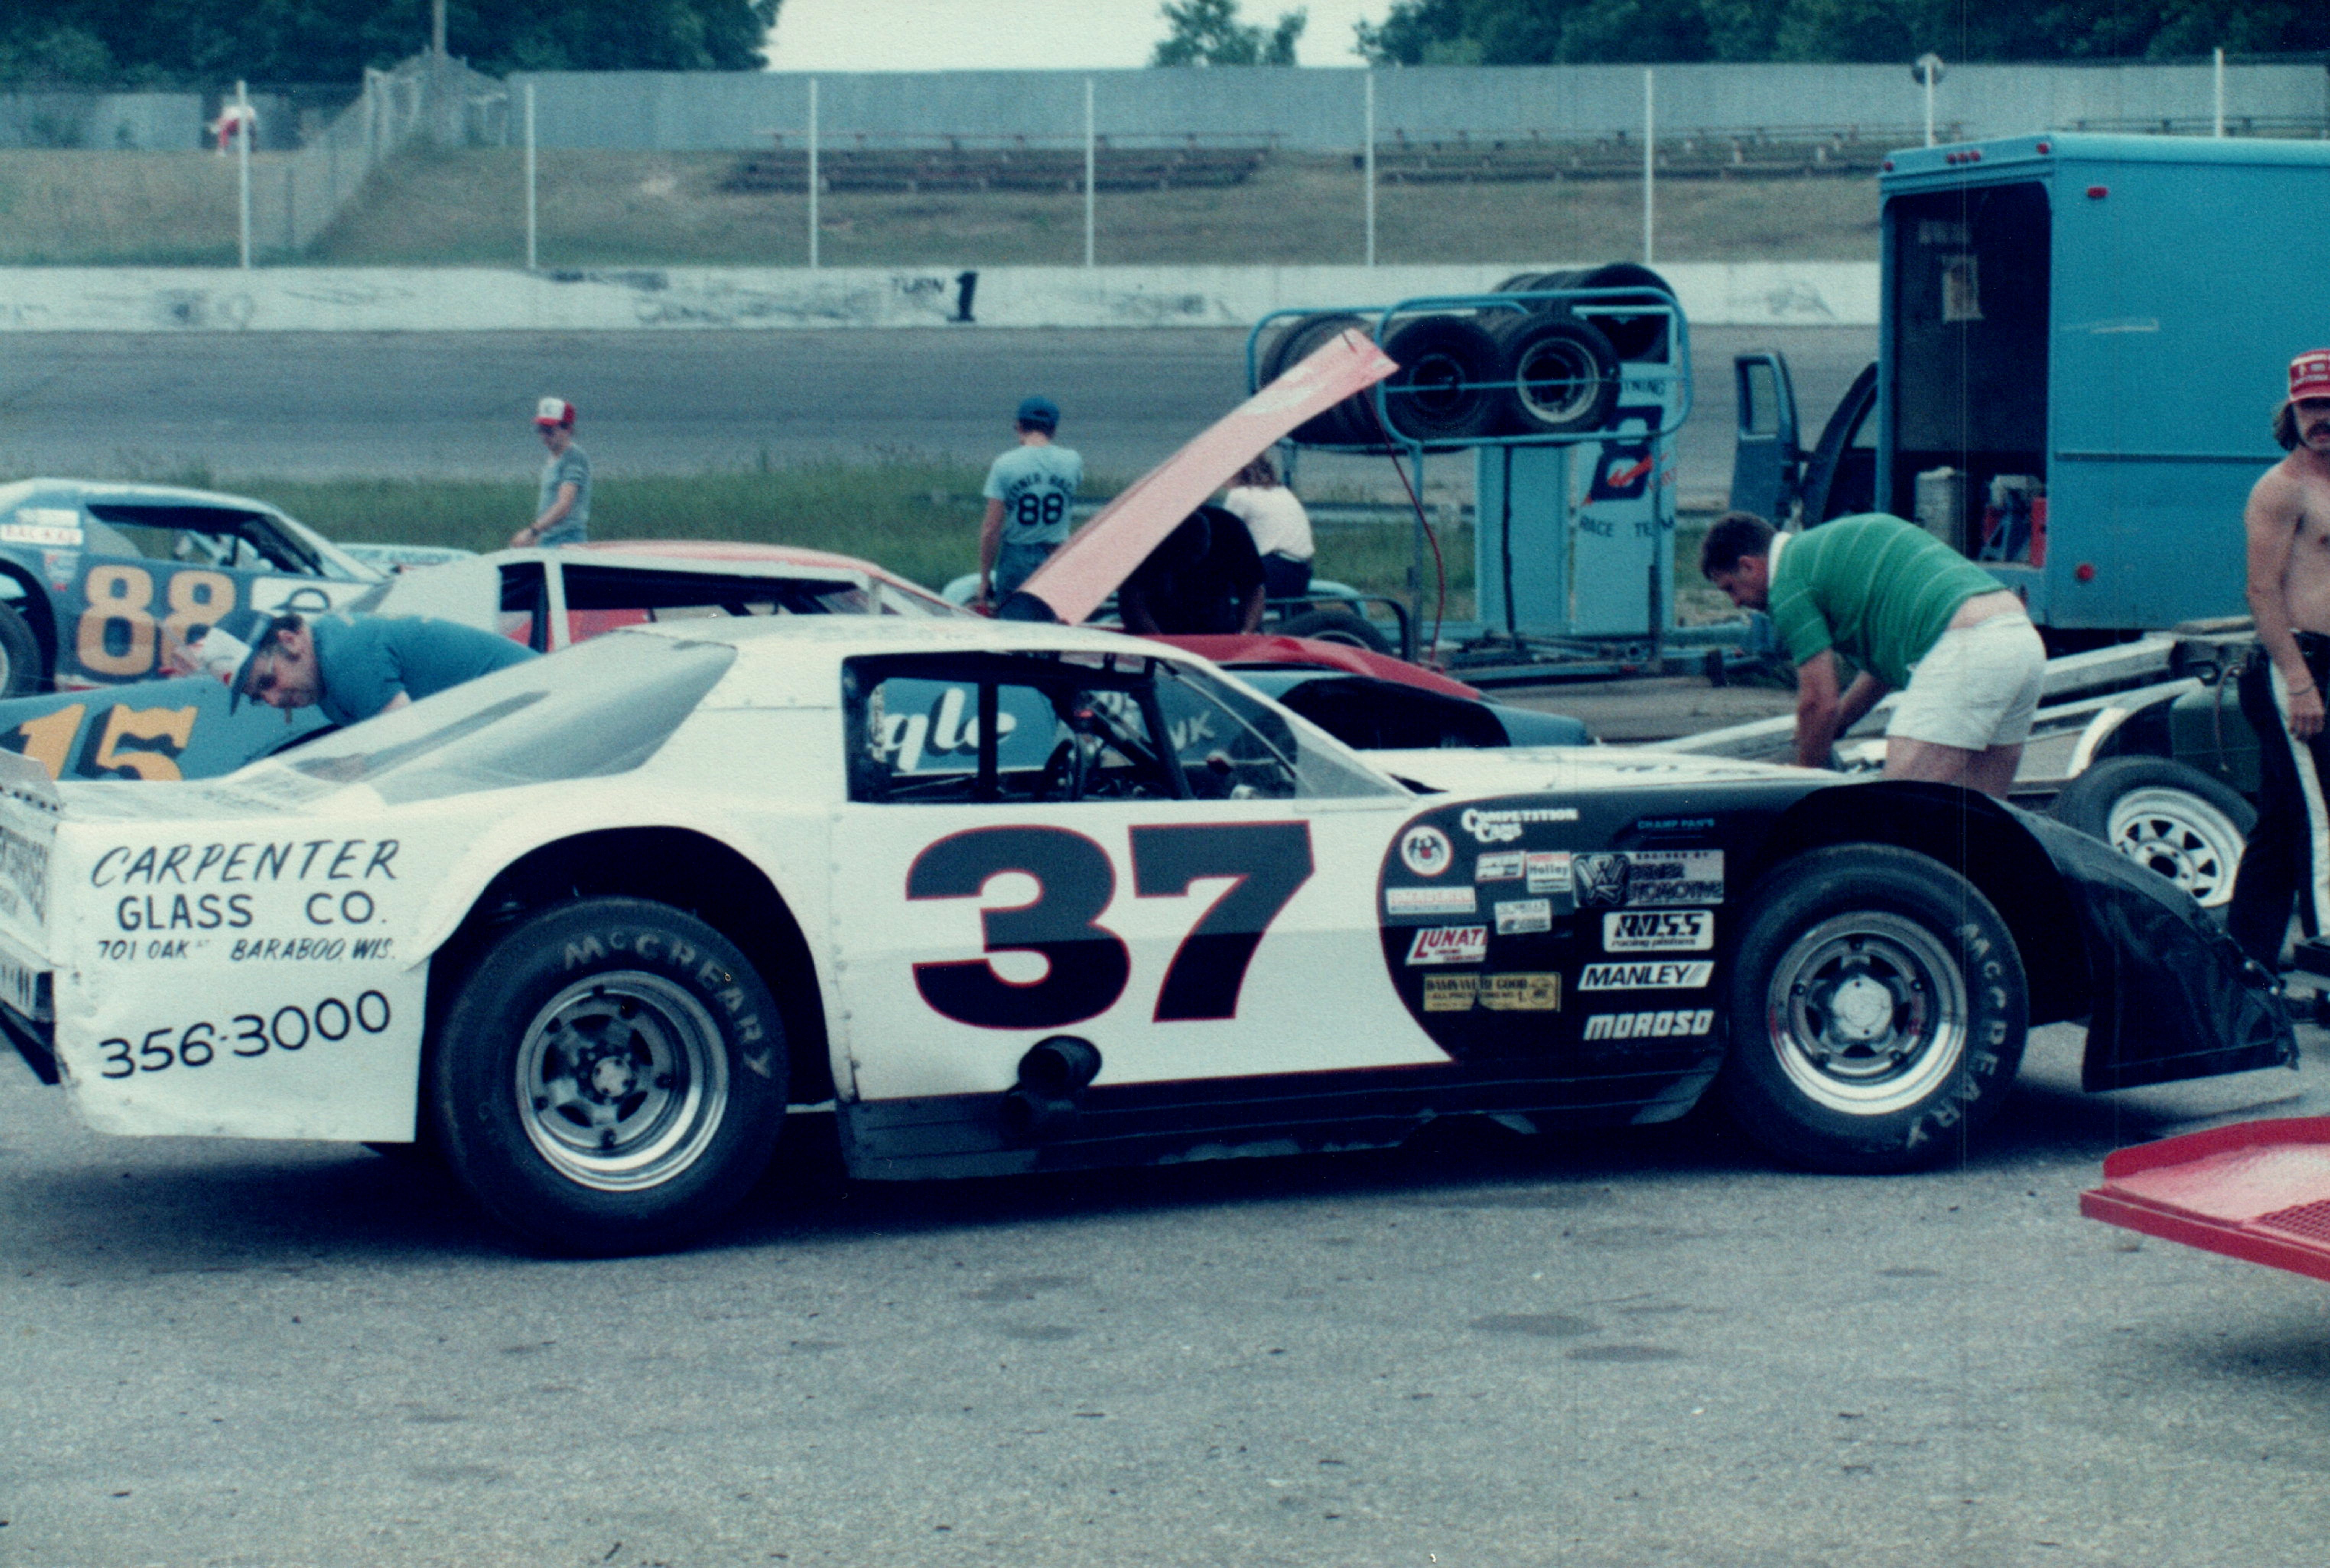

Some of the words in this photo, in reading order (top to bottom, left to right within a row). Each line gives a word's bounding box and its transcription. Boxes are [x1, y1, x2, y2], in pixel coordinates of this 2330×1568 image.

[947, 271, 979, 322] 1
[1017, 492, 1064, 526] 88
[1635, 516, 1674, 537] TEM
[77, 564, 236, 676] 88
[18, 703, 198, 781] 15
[91, 839, 400, 888] CARPENTER
[1530, 863, 1568, 877] Holley
[117, 894, 253, 931] GLASS
[306, 891, 387, 925] CO.
[905, 819, 1315, 1030] 37
[1613, 913, 1704, 937] ROSS
[97, 940, 136, 960] 701
[147, 939, 190, 960] OAK
[351, 937, 397, 960] WIS.
[1611, 939, 1650, 948] racing
[1584, 964, 1691, 987] MANLEY
[98, 990, 391, 1079] 356-3000
[1583, 1010, 1714, 1041] MOROSO
